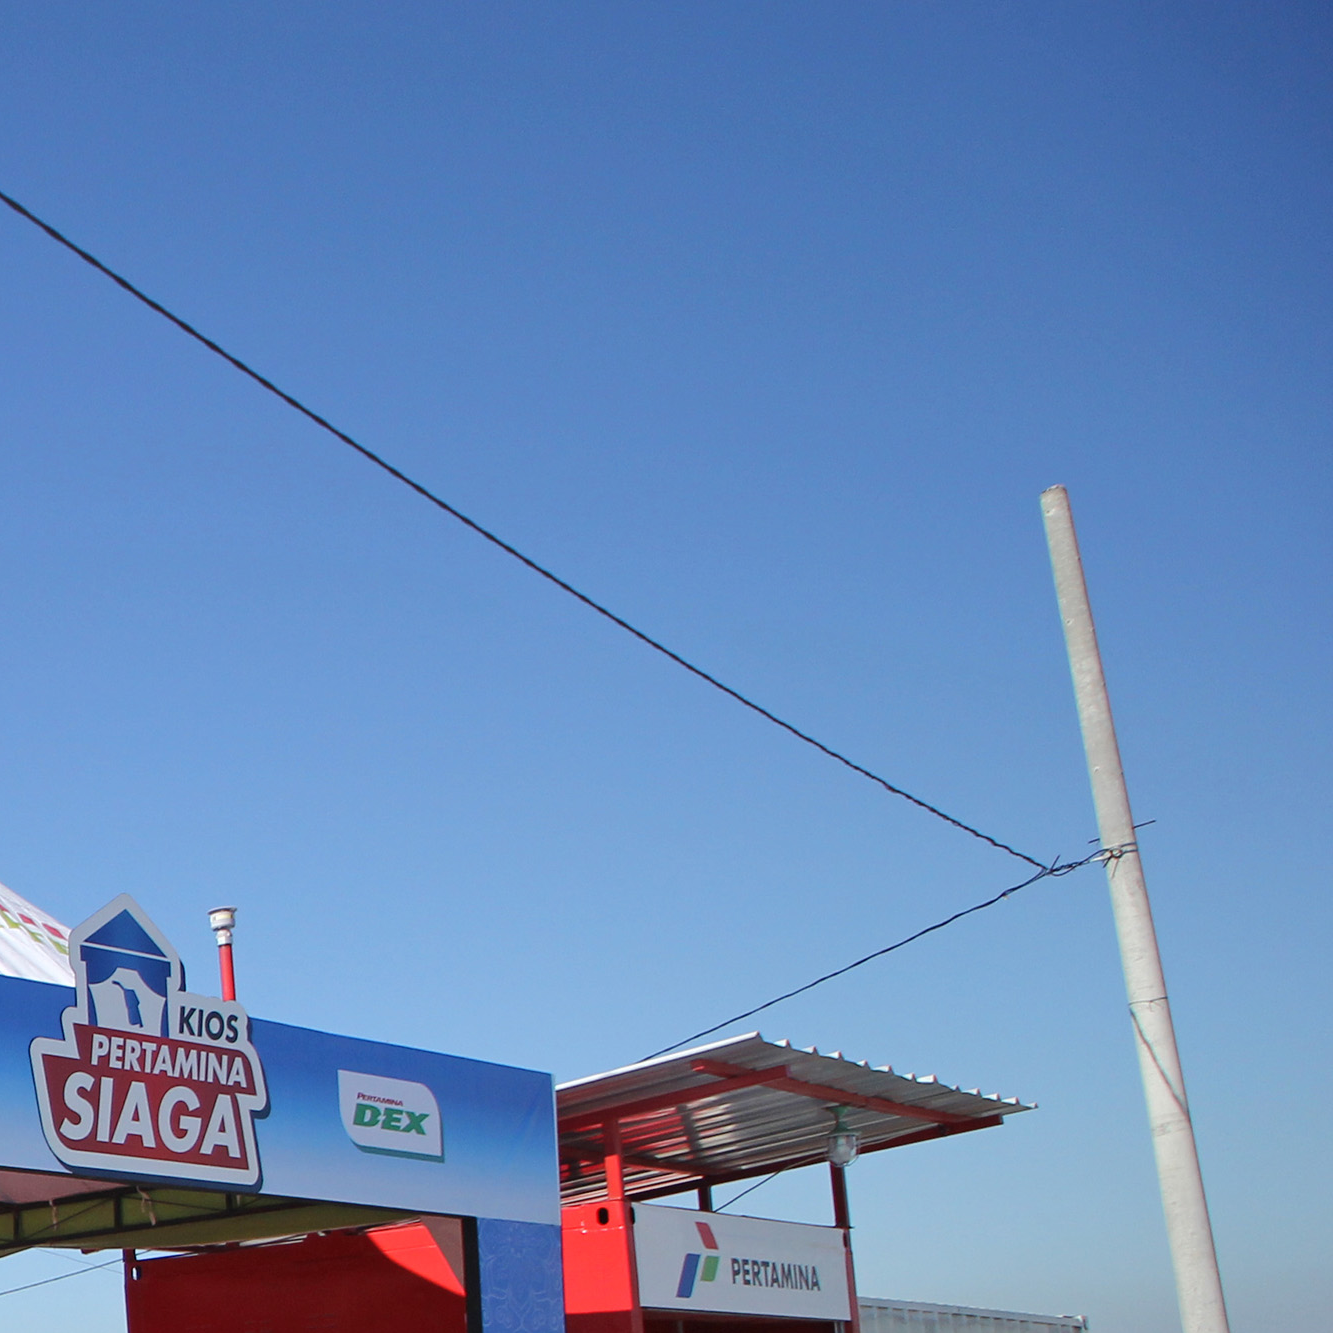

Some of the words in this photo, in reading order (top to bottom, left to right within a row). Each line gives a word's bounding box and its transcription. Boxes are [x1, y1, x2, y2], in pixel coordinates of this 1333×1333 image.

[179, 1006, 238, 1042] KIOS
[91, 1034, 247, 1087] PERTAMINA
[60, 1071, 241, 1158] SIAGA
[357, 1092, 403, 1106] PERTAMINA
[353, 1103, 429, 1135] DEX
[731, 1258, 821, 1291] PERTAMINA
